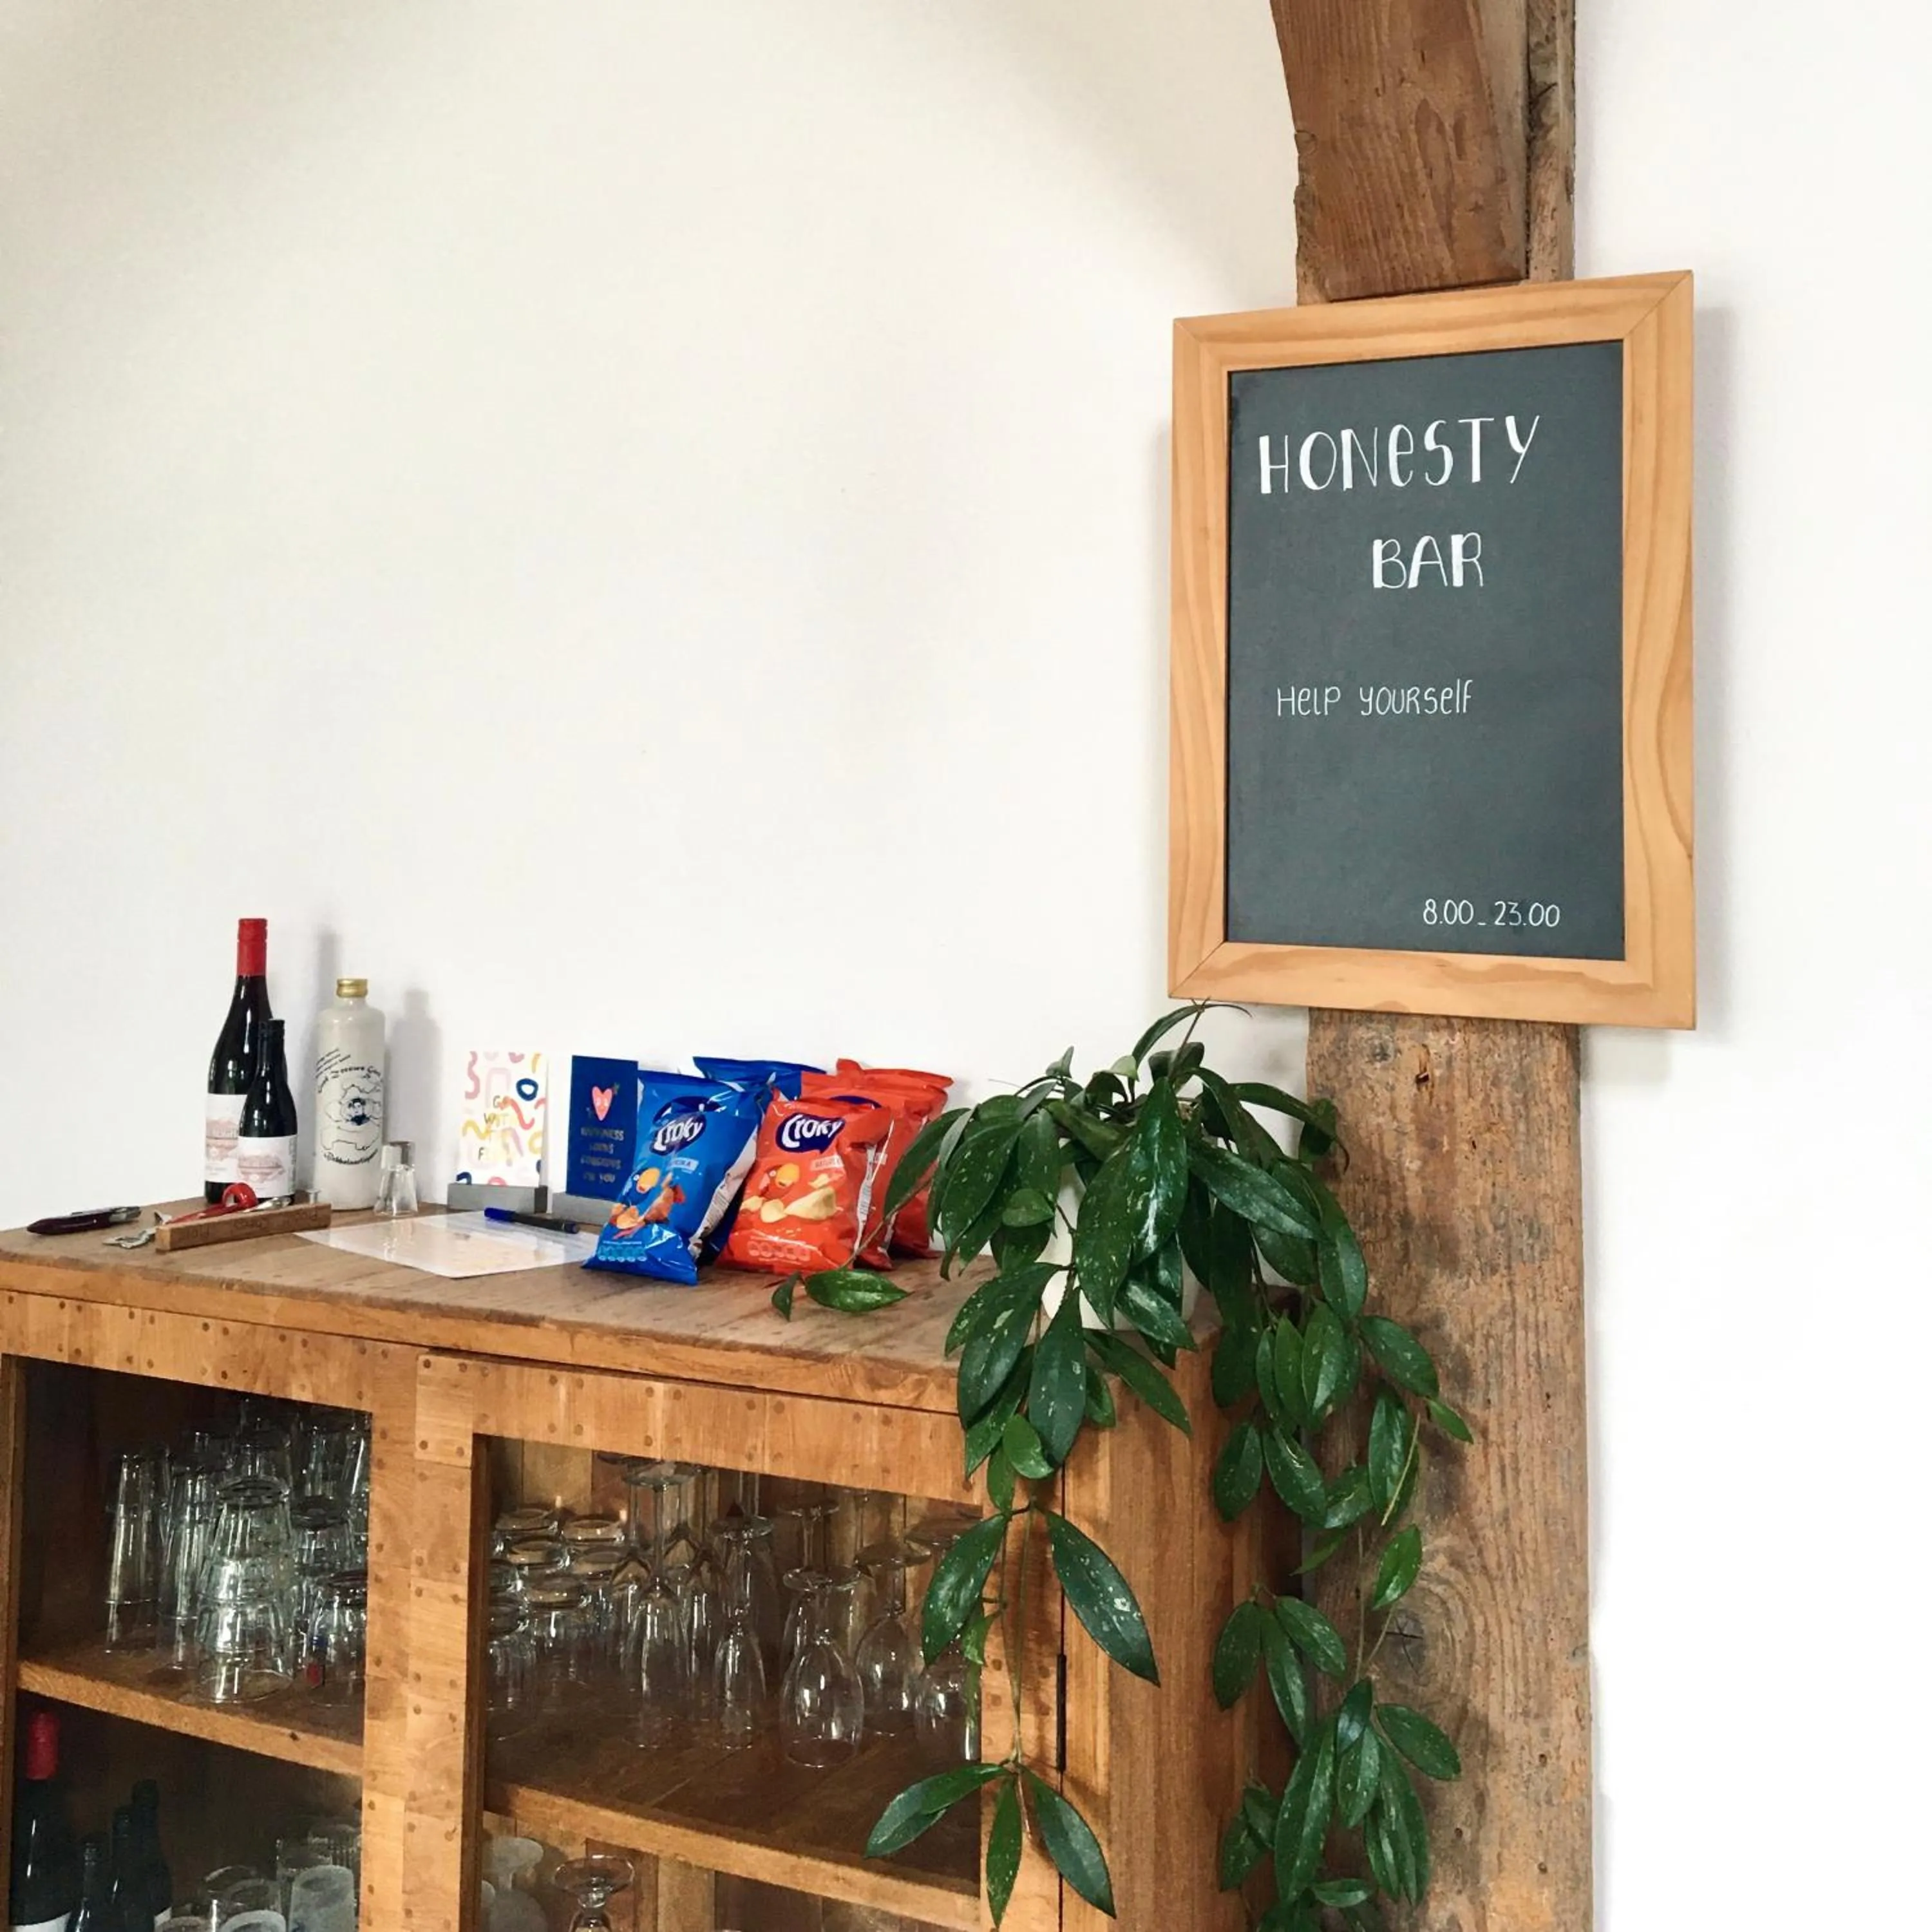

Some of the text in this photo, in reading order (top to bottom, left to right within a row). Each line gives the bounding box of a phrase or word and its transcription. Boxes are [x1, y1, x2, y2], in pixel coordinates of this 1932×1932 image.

[1372, 531, 1484, 590] BAR
[1422, 898, 1475, 925] 8.00
[1493, 900, 1561, 928] 23.00
